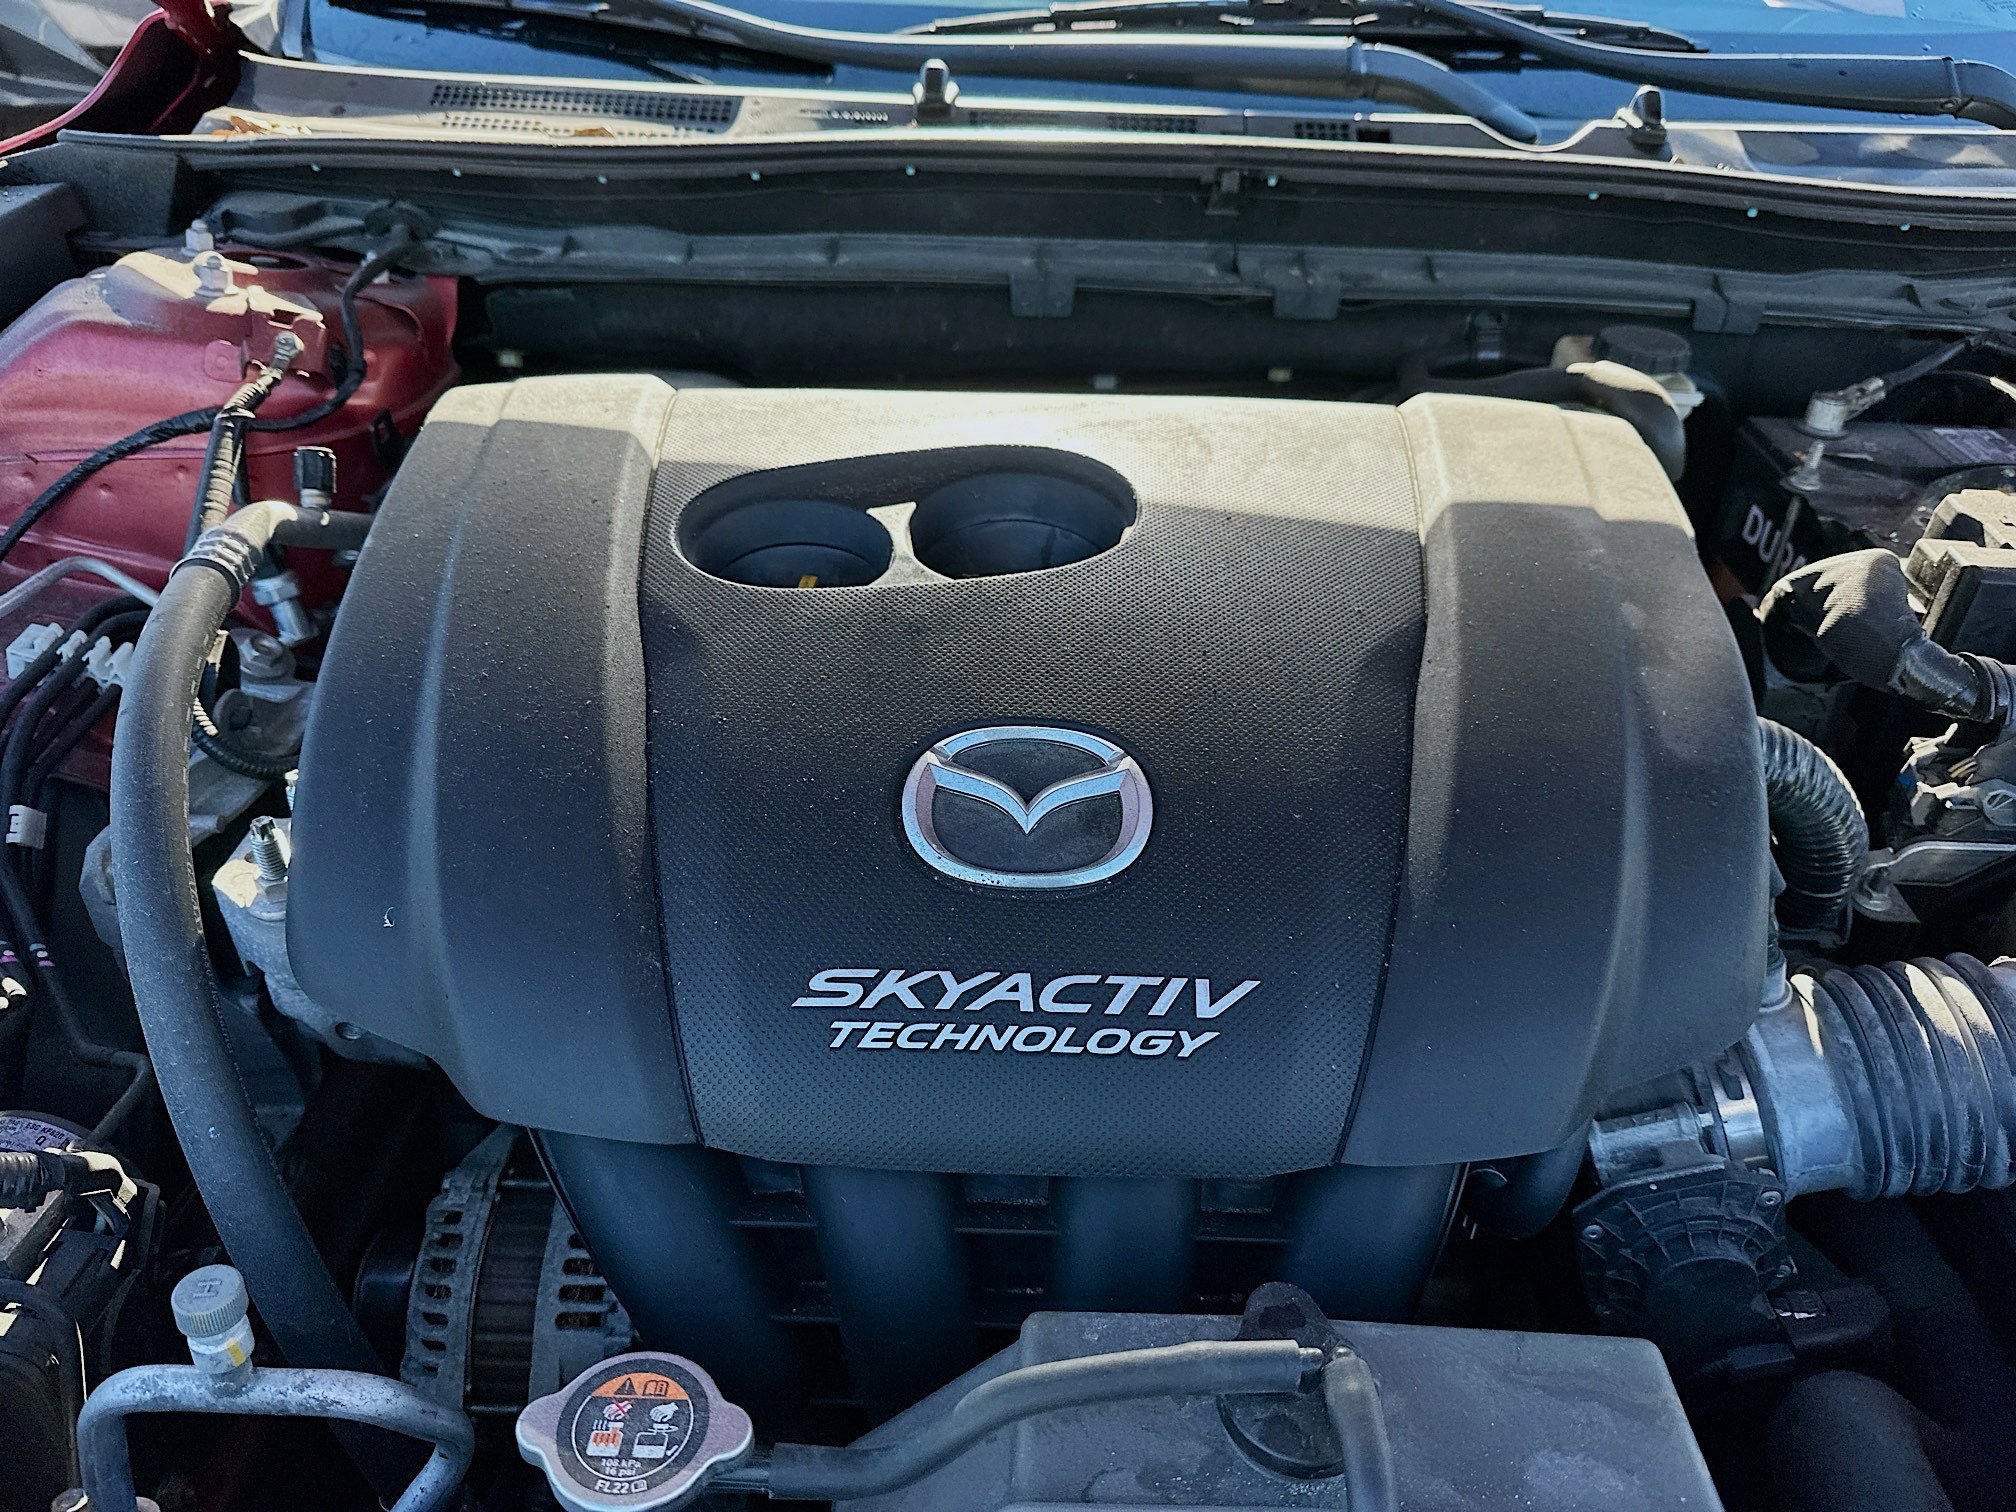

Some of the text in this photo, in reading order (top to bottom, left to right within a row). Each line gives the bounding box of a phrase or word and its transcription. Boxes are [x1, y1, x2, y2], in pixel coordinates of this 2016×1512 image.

[791, 968, 1261, 1019] SKYACTIV
[829, 1021, 1221, 1058] TECHNOLOGY
[621, 1459, 641, 1468] kPa
[605, 1467, 637, 1477] 16 psi
[594, 1479, 630, 1494] FL22
